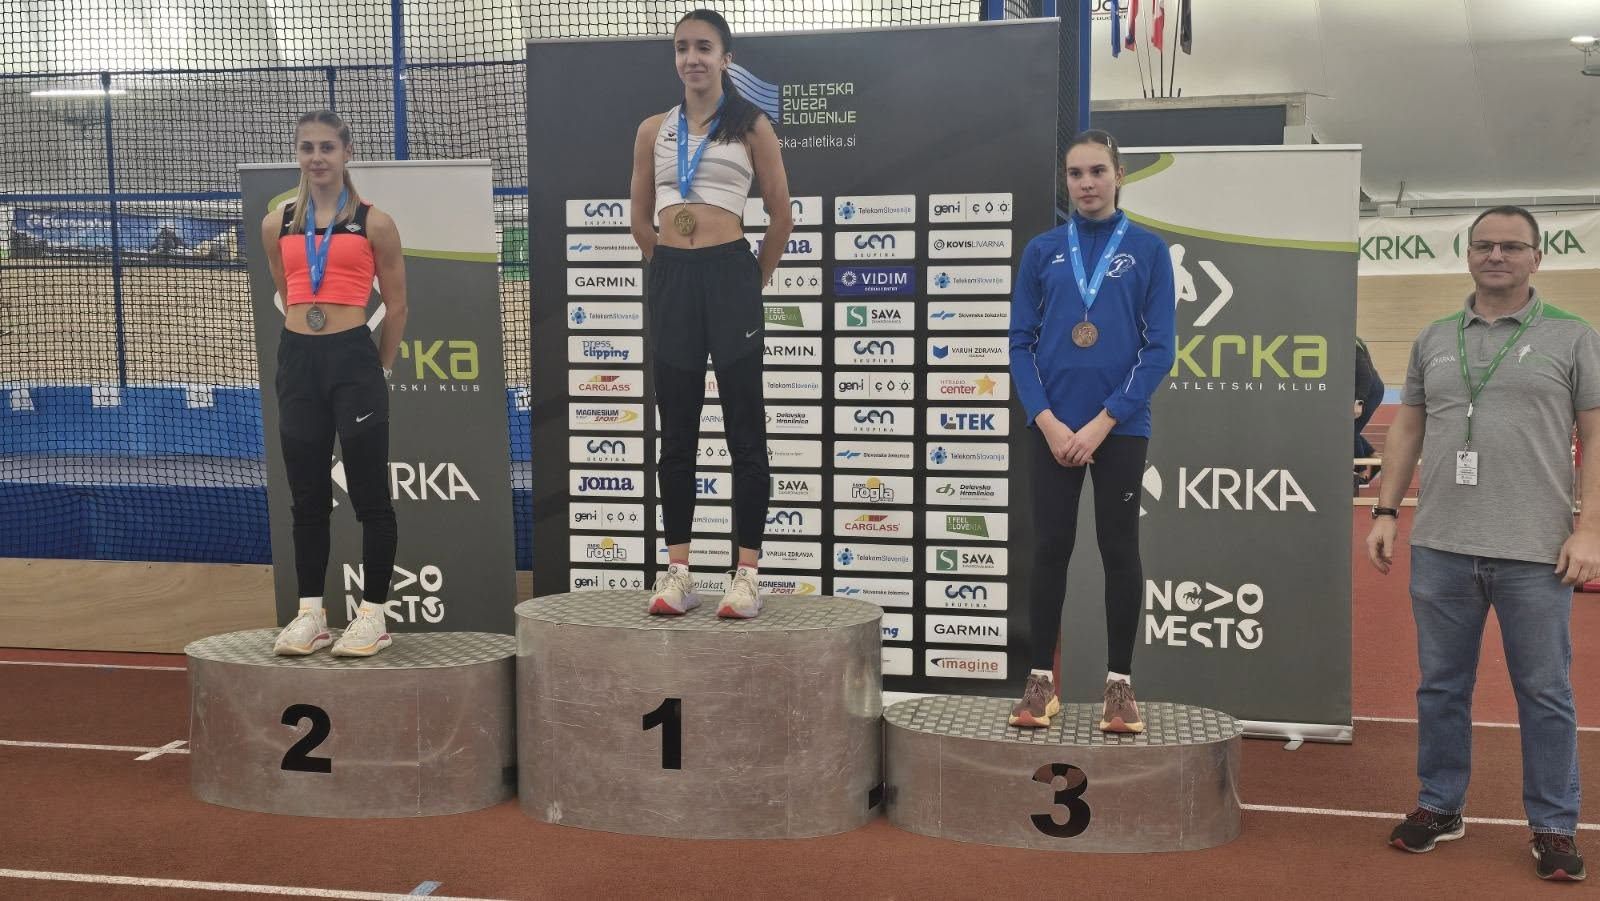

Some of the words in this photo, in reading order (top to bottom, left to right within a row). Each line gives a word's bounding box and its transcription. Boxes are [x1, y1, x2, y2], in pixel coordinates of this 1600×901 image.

[783, 83, 854, 96] ATLETSKA
[783, 98, 827, 110] ZVEZA
[783, 111, 856, 124] SLOVENIJE
[778, 134, 856, 148] ska-atletika.si
[1358, 234, 1435, 260] KRKA
[1544, 230, 1586, 255] KA
[575, 277, 635, 287] GARMIN
[862, 272, 907, 284] VIDIM
[872, 310, 901, 319] SAVA
[582, 341, 610, 350] press
[764, 346, 814, 356] ARMIN
[399, 340, 479, 380] ka
[584, 347, 629, 360] clipping
[941, 385, 976, 394] center
[1169, 382, 1262, 390] ATLETSKI
[1278, 382, 1326, 391] KLUB
[390, 462, 480, 500] RKA
[578, 476, 634, 491] Joma
[696, 478, 718, 494] EK
[778, 481, 808, 490] SAVA
[852, 483, 894, 502] rogla
[1178, 467, 1316, 512] KRKA
[844, 522, 899, 532] CARGLASS
[587, 544, 626, 561] rogla
[962, 554, 994, 564] SAVA
[934, 624, 998, 636] GARMIN
[1145, 614, 1263, 650] MESTO
[942, 659, 998, 672] imagine
[280, 704, 332, 774] 2
[642, 698, 682, 770] 1
[1030, 763, 1091, 838] 3
